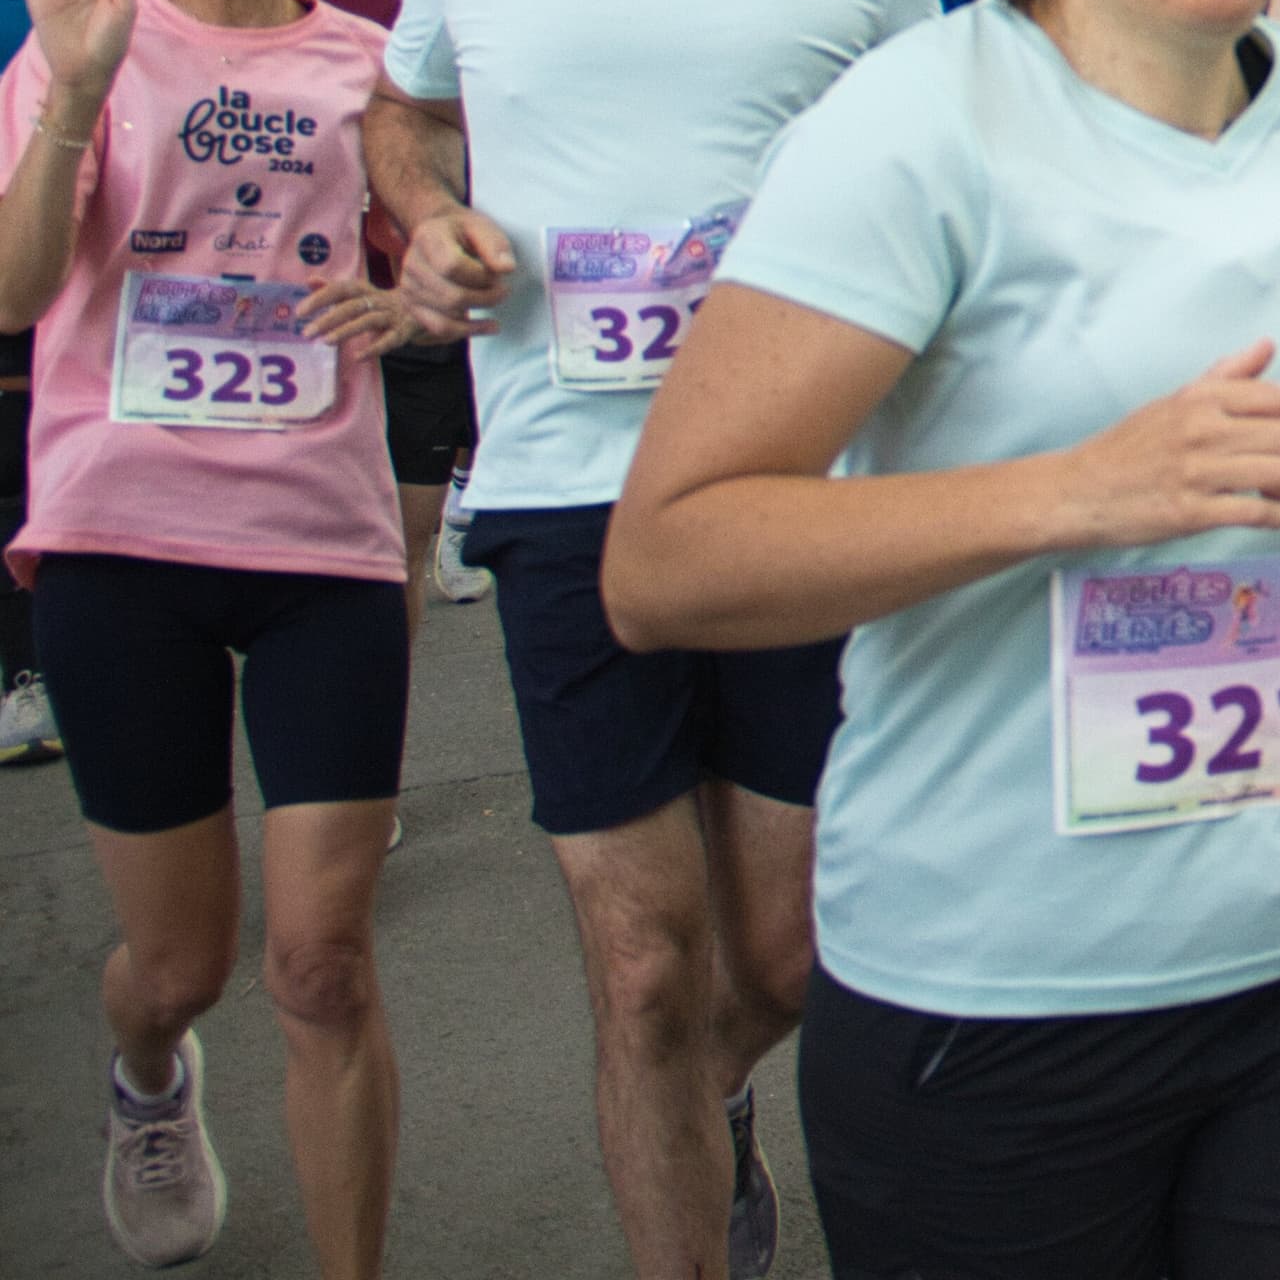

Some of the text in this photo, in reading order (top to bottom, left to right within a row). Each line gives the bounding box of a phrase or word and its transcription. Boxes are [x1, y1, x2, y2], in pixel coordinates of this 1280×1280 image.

[219, 85, 250, 109] la
[591, 297, 708, 362] 32
[163, 348, 297, 405] 323
